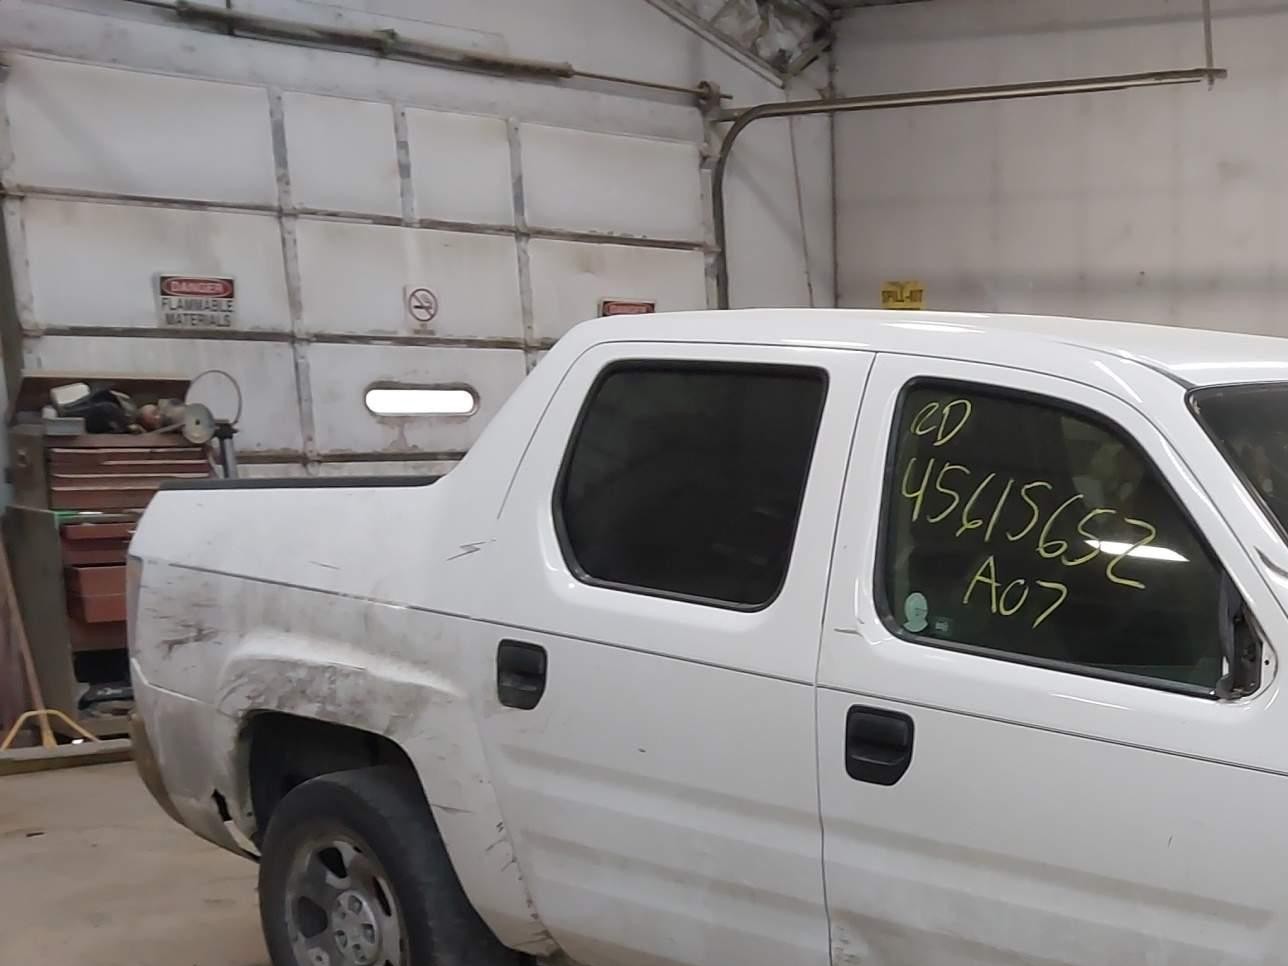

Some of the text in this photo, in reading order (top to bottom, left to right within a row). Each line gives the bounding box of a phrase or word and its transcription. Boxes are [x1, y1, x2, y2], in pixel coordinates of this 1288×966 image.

[170, 281, 224, 293] DANGER
[161, 297, 234, 312] FLAMMABLE
[165, 312, 232, 327] MATERIALS
[901, 456, 1158, 590] 45615652
[962, 555, 1069, 629] A07
